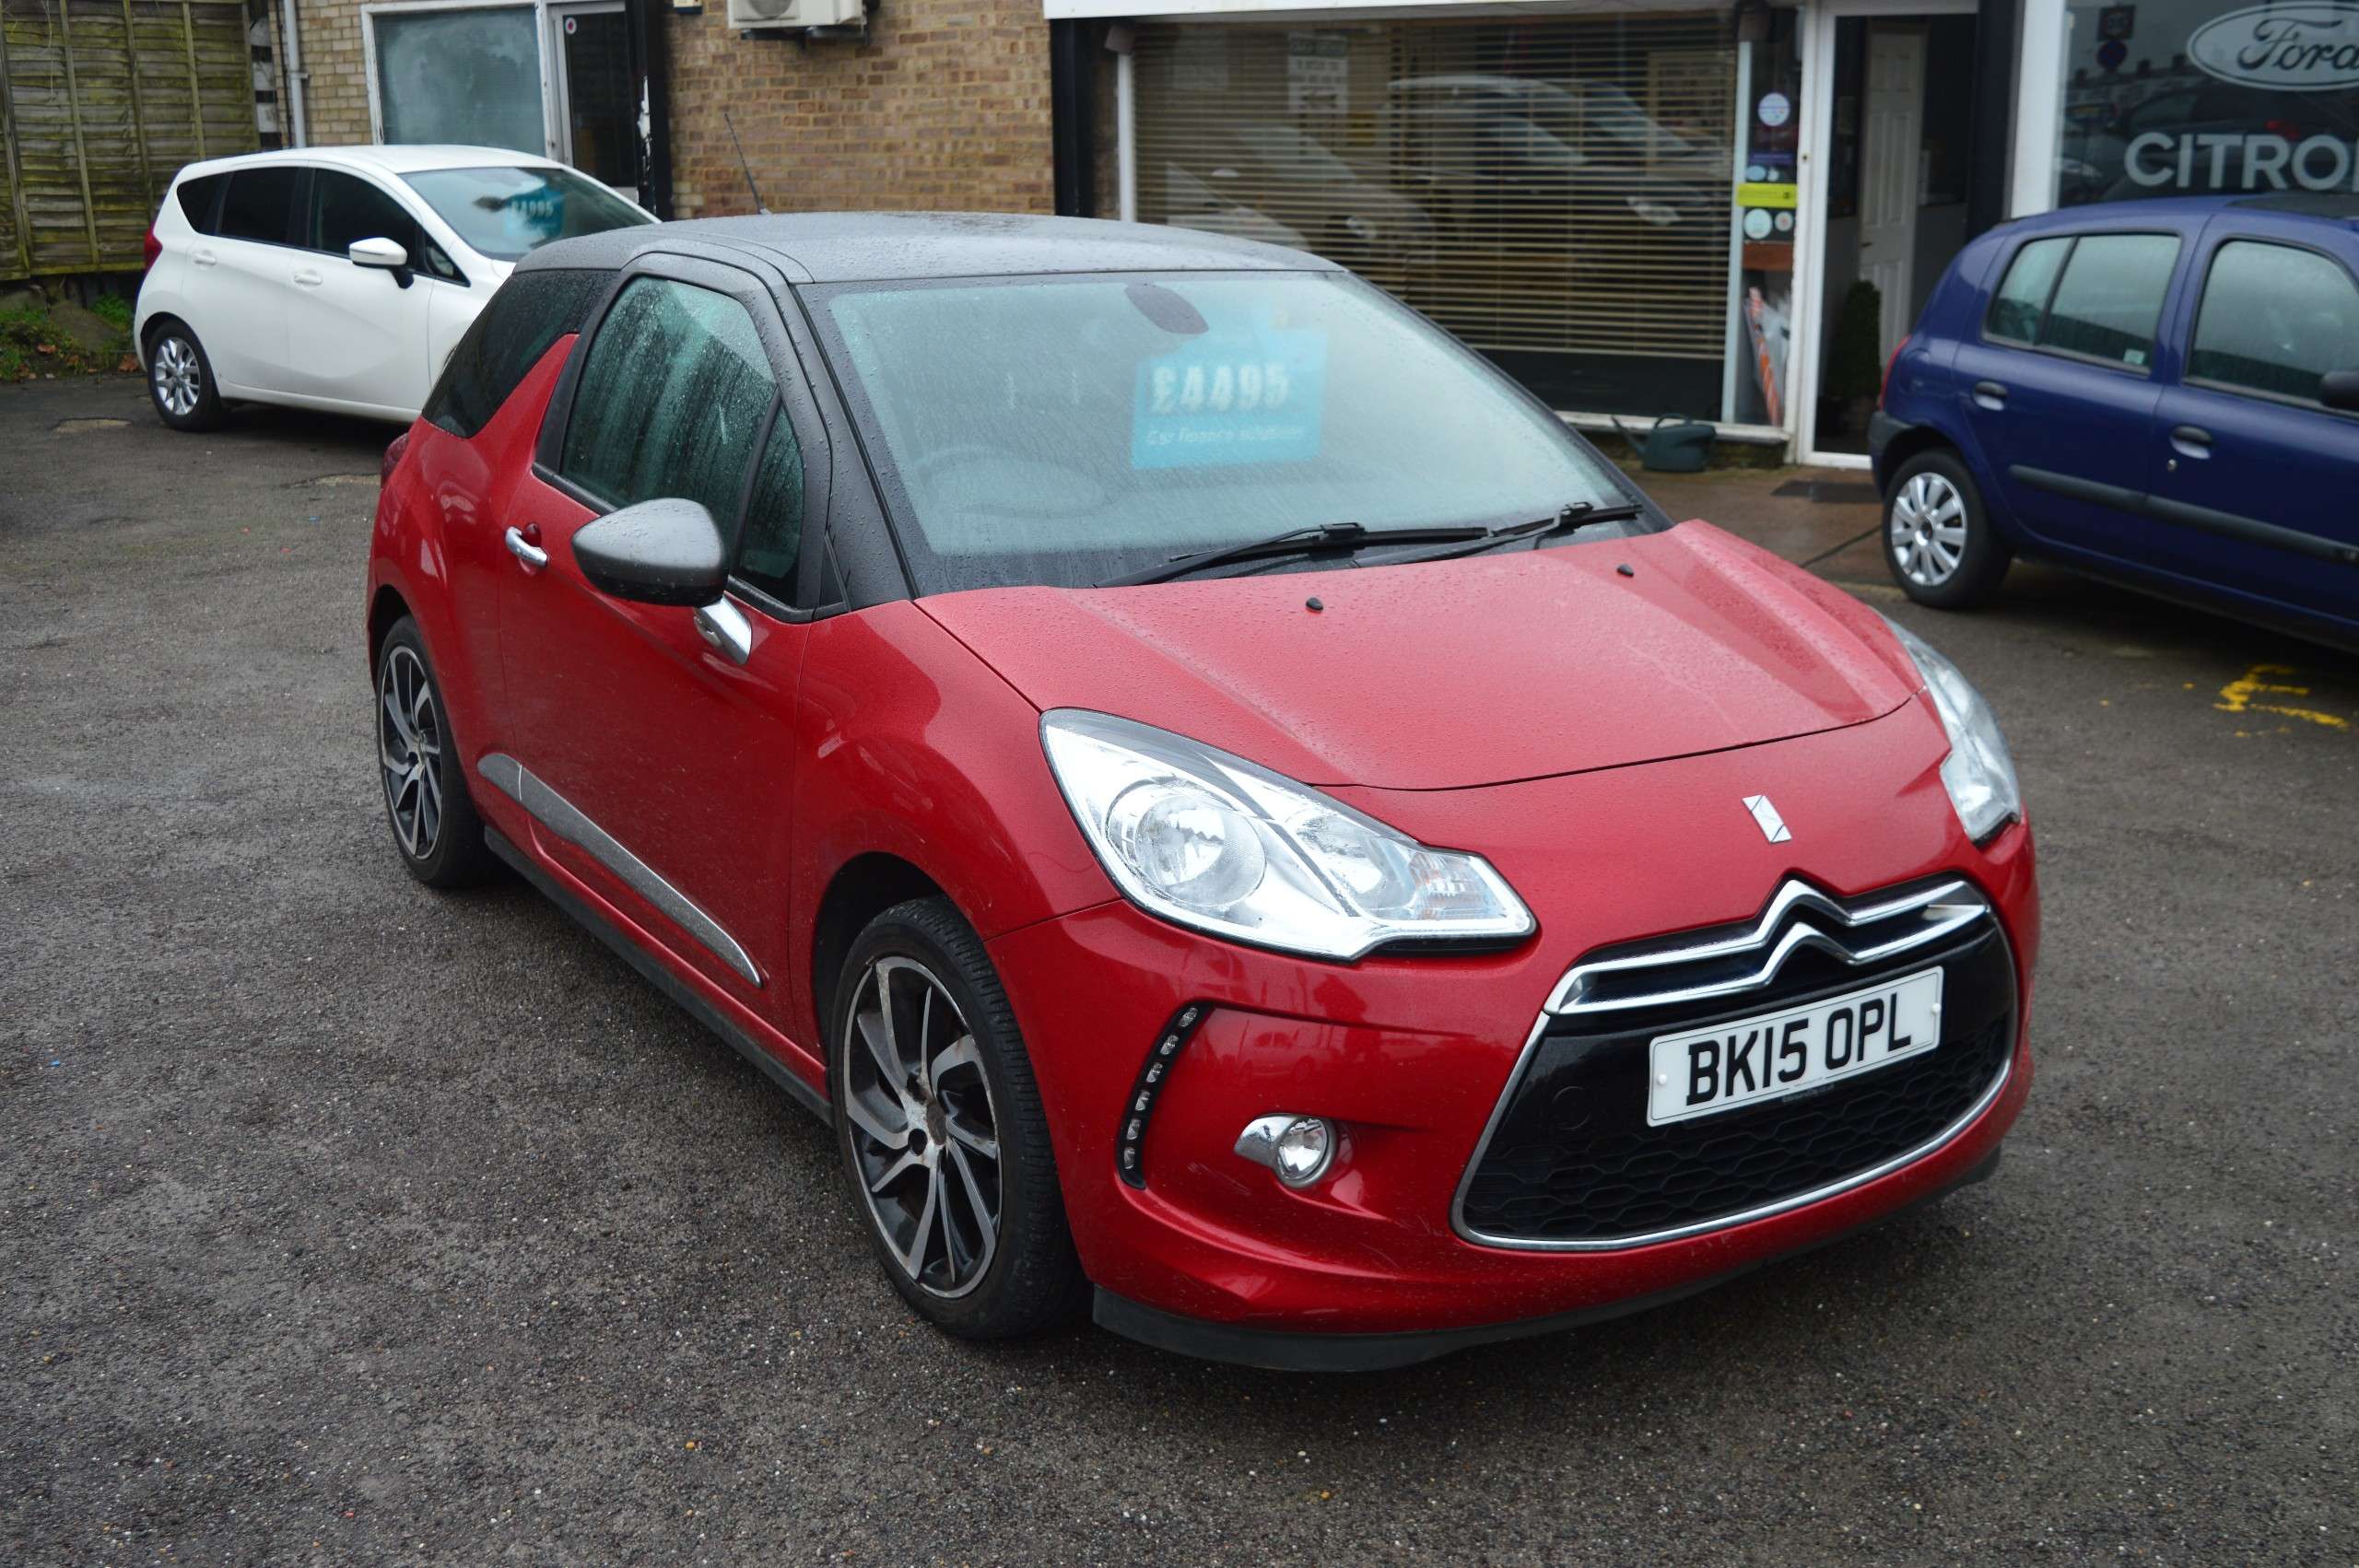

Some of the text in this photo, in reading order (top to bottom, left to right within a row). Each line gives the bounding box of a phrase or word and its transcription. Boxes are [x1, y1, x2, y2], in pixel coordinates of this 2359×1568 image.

[2124, 131, 2359, 193] CITRO
[1152, 364, 1290, 414] £4495
[1685, 991, 1912, 1106] BK15 OPL
